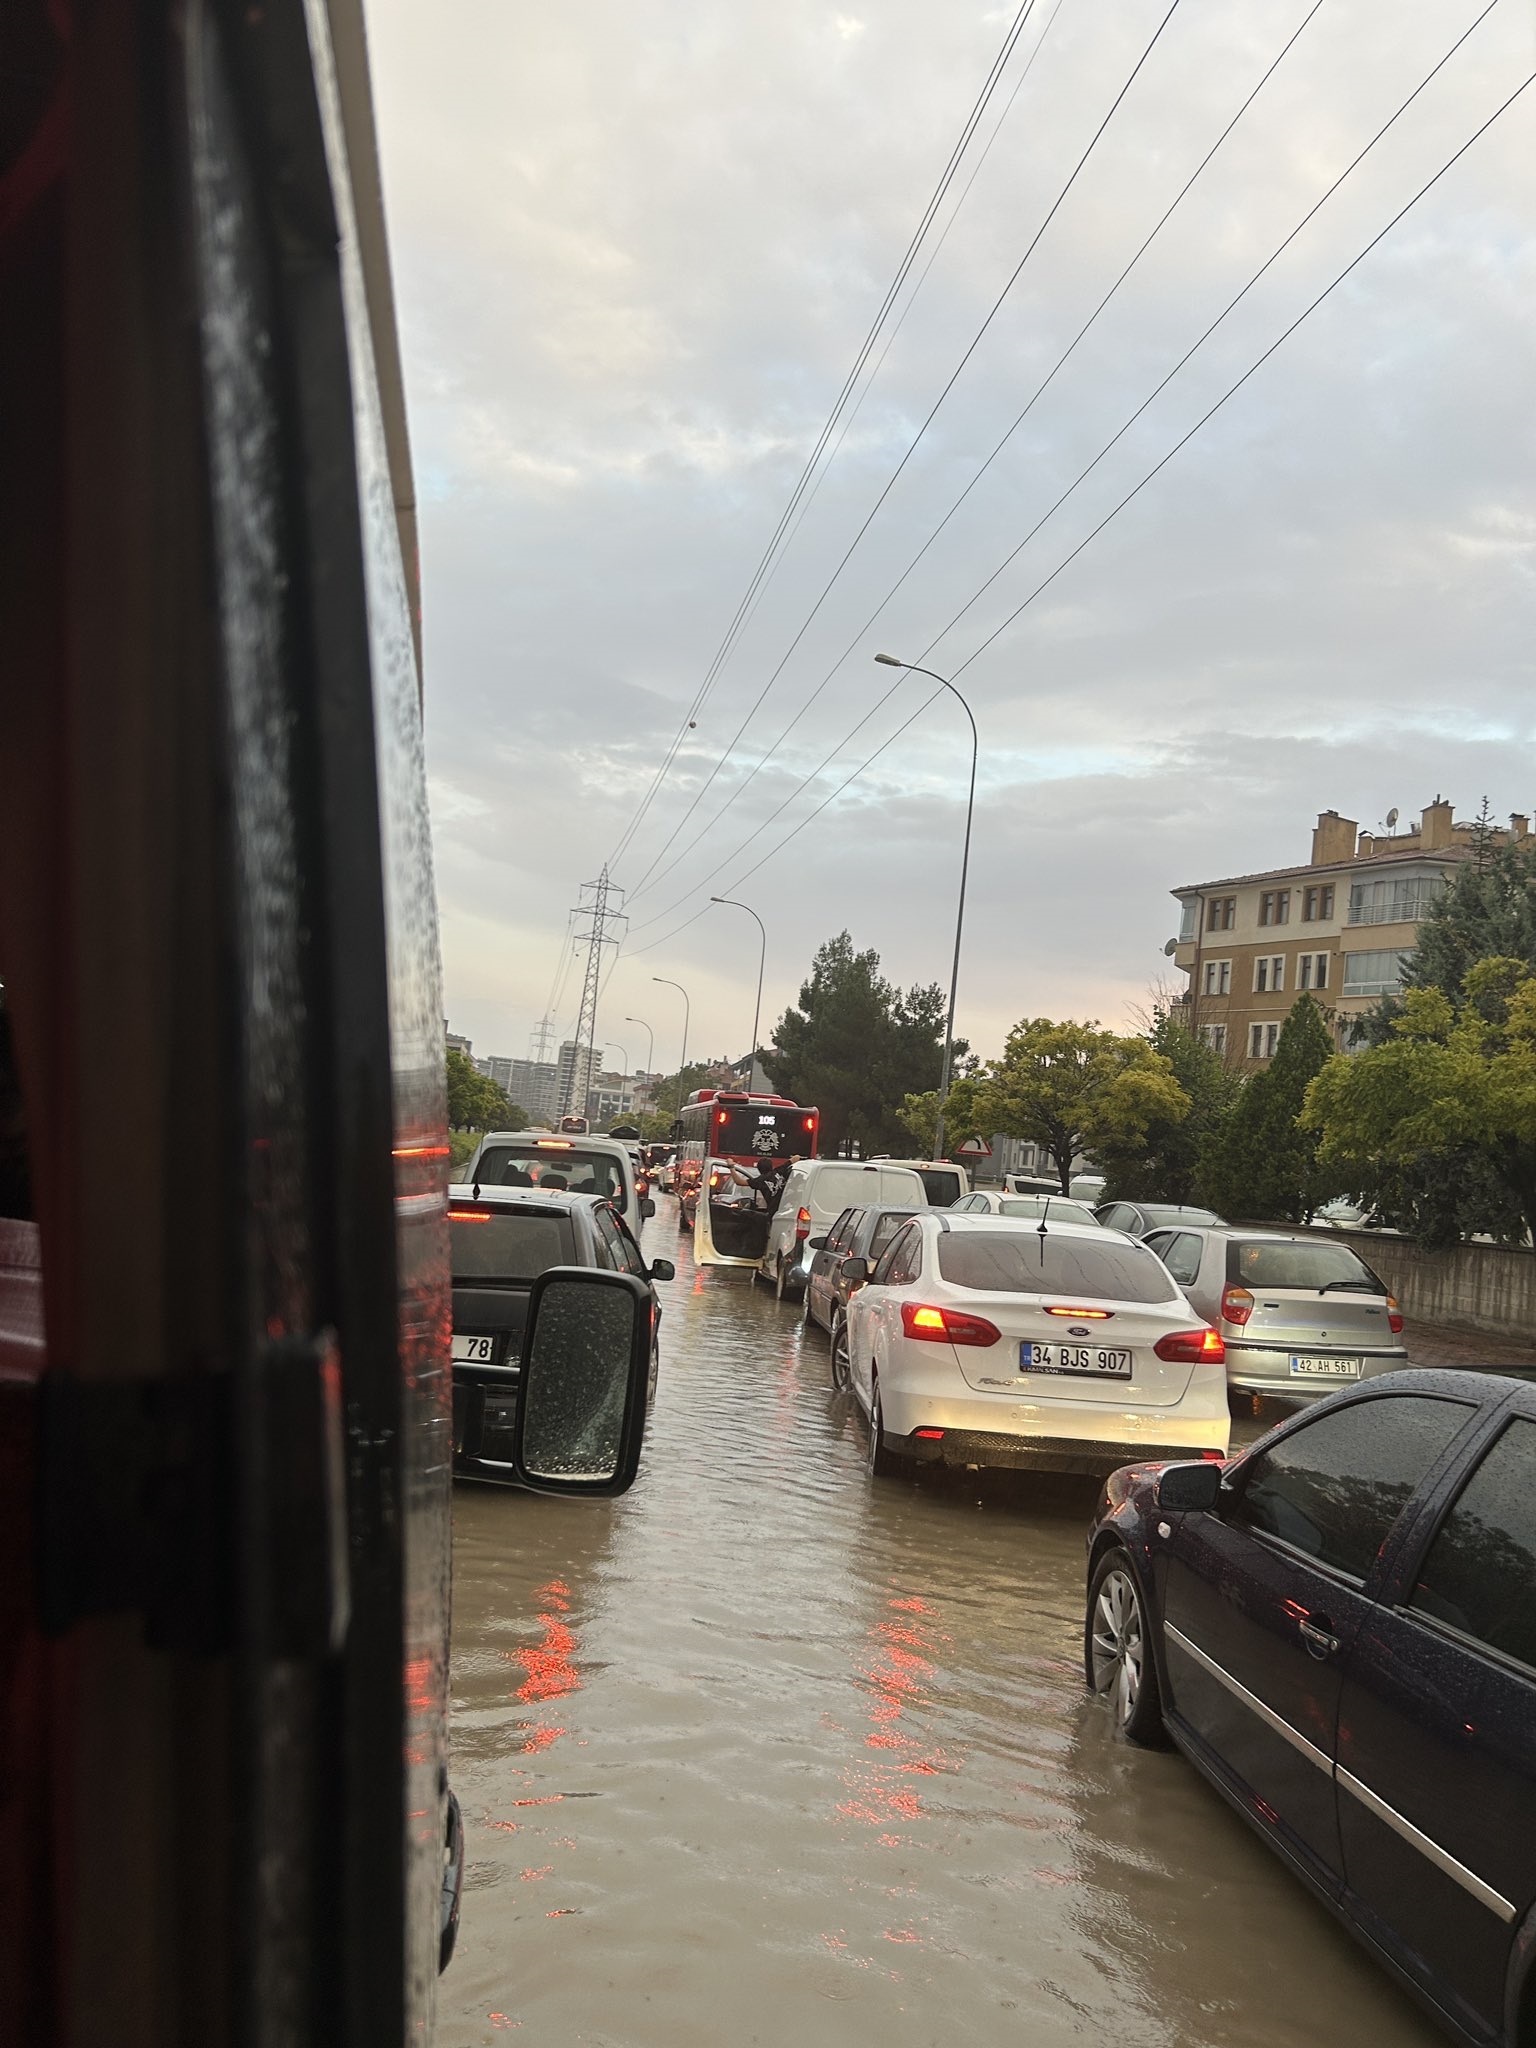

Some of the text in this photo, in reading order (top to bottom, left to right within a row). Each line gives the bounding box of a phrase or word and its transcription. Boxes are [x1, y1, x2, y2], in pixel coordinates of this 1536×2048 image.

[467, 1338, 489, 1358] 78
[1032, 1346, 1052, 1365] 34
[1060, 1348, 1089, 1368] BJS
[1097, 1351, 1127, 1371] 907
[1300, 1359, 1351, 1373] 42 AH 561
